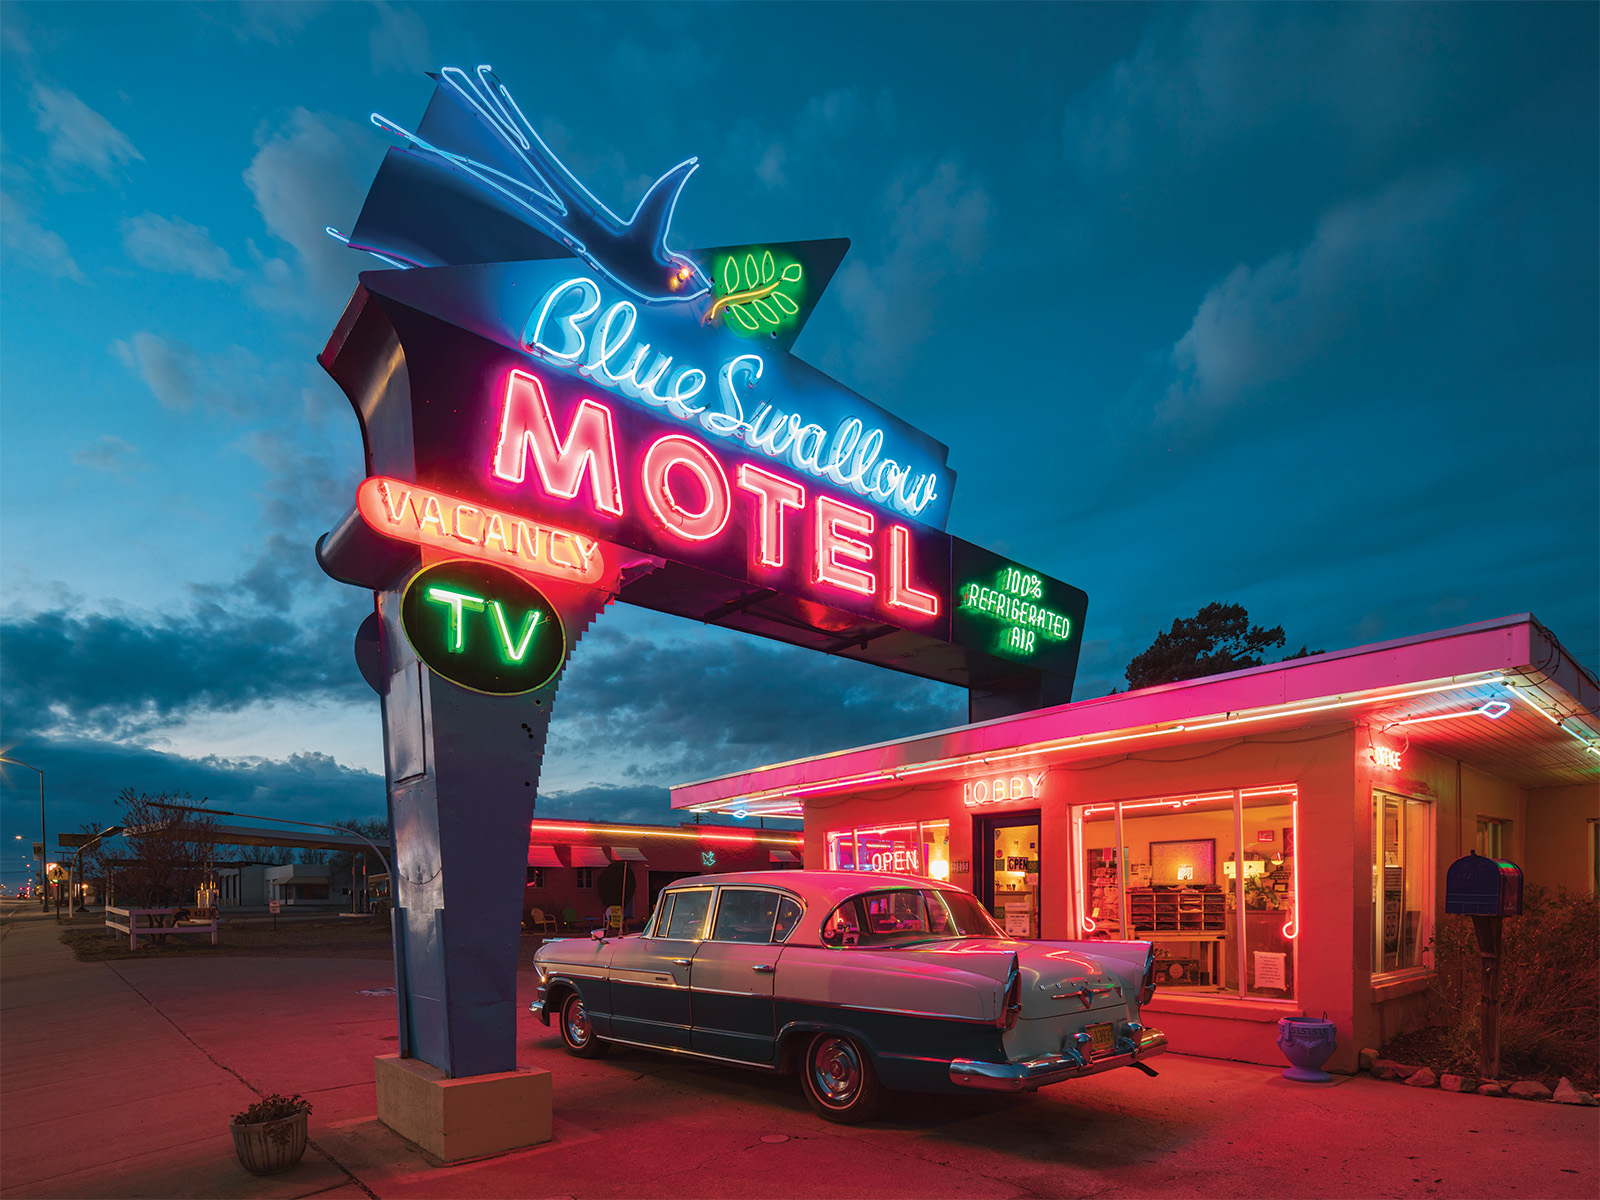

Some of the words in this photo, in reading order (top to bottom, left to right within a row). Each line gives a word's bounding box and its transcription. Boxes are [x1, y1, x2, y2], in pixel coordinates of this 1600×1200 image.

[524, 277, 711, 419] Blue
[702, 354, 938, 516] Swallow
[492, 369, 938, 617] MOTEL
[377, 482, 597, 572] VACANCY
[1005, 567, 1041, 598] 100%
[428, 588, 540, 663] TV
[966, 583, 1070, 639] REFRIGERATED
[1010, 627, 1035, 653] AIR
[963, 774, 1042, 805] LOBBY
[872, 850, 918, 872] OPEN
[1008, 857, 1028, 871] OPEN
